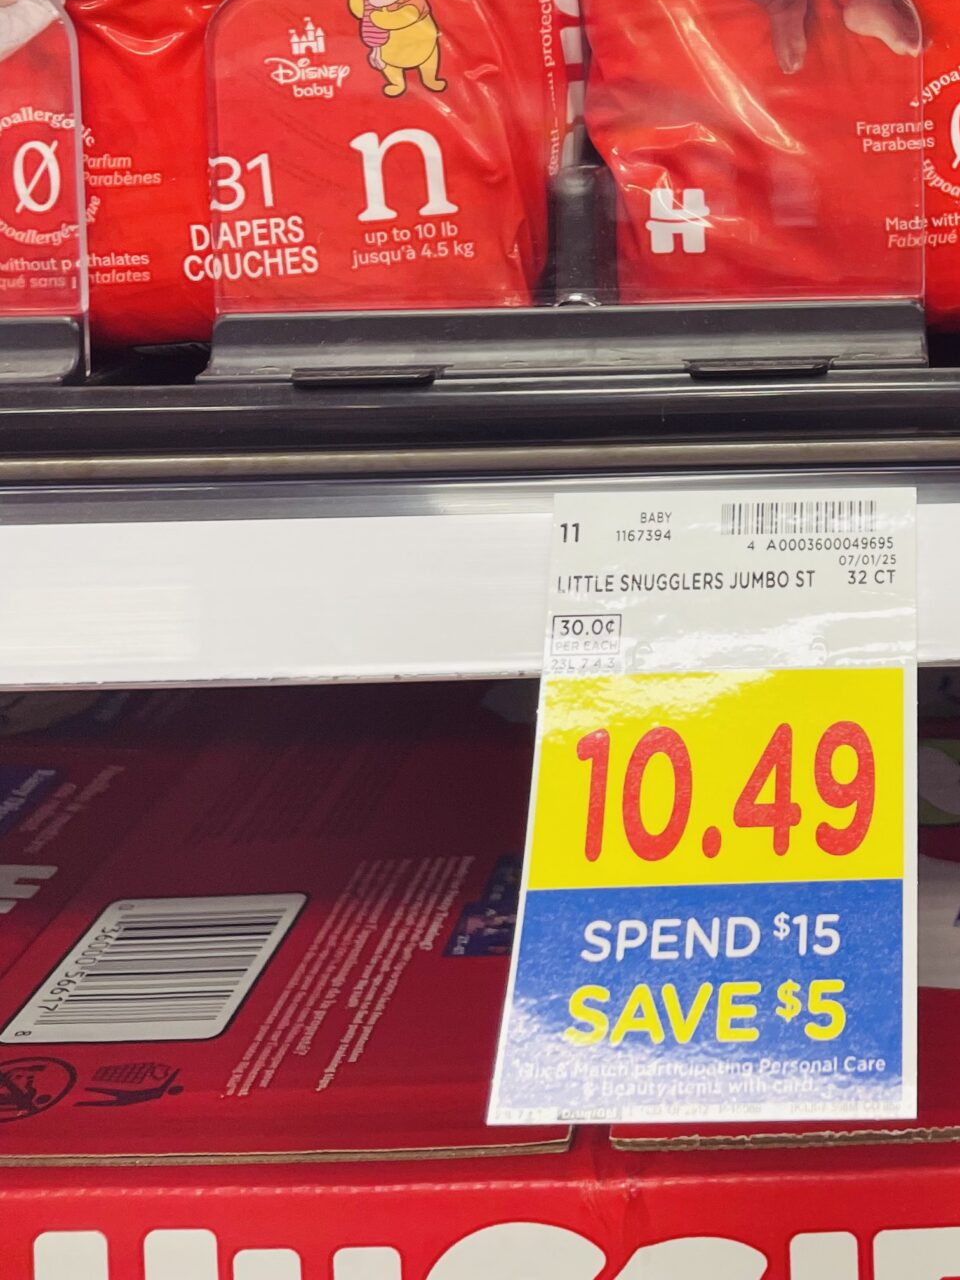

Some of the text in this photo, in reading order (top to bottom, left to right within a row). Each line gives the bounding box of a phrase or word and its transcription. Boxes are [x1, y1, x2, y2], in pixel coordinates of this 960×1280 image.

[293, 83, 334, 99] baby
[208, 153, 274, 212] 31
[350, 128, 459, 221] n
[190, 215, 305, 251] DIAPERS
[365, 221, 458, 247] up to 10 lb
[184, 245, 319, 282] COUCHES
[352, 240, 475, 268] jusqu'à 4.5 kg
[640, 511, 672, 524] BABY
[560, 522, 672, 543] 11 1167394
[747, 537, 894, 552] 4 A0003600049695
[839, 554, 897, 567] 07/01/25
[557, 569, 896, 594] LITTLE SNUGGLERS JUMBO ST 32 CT
[559, 618, 616, 637] 30.0¢
[555, 640, 618, 652] PER EACH
[576, 720, 876, 863] 10.49
[581, 911, 841, 963] SPEND $15
[37, 970, 84, 1012] 56617
[564, 978, 847, 1045] SAVE $5
[759, 1056, 838, 1075] Personal
[844, 1055, 886, 1071] Care
[729, 1077, 767, 1094] with
